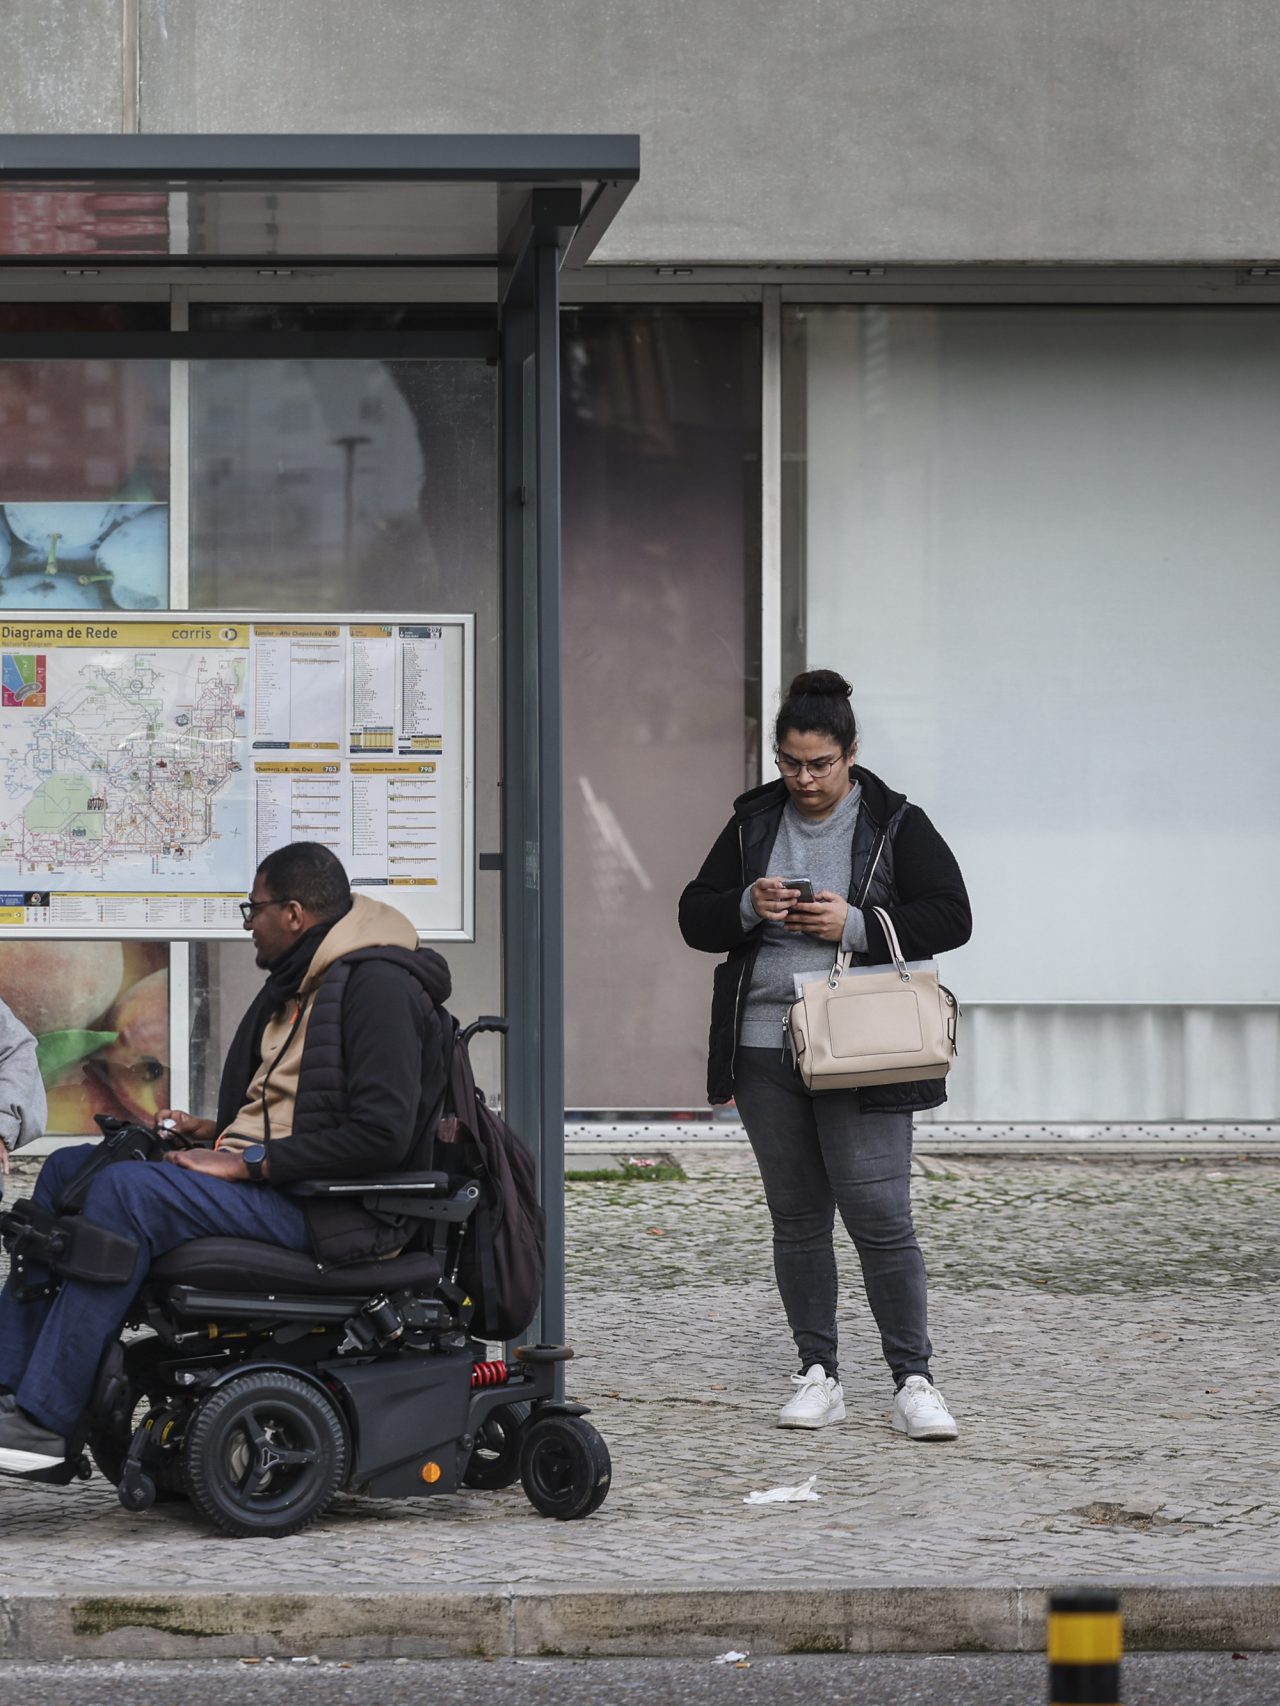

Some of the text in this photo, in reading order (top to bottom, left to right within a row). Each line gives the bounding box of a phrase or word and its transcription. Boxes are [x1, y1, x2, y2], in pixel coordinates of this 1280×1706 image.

[2, 627, 118, 641] Diagrama de Rede
[171, 626, 212, 640] carris
